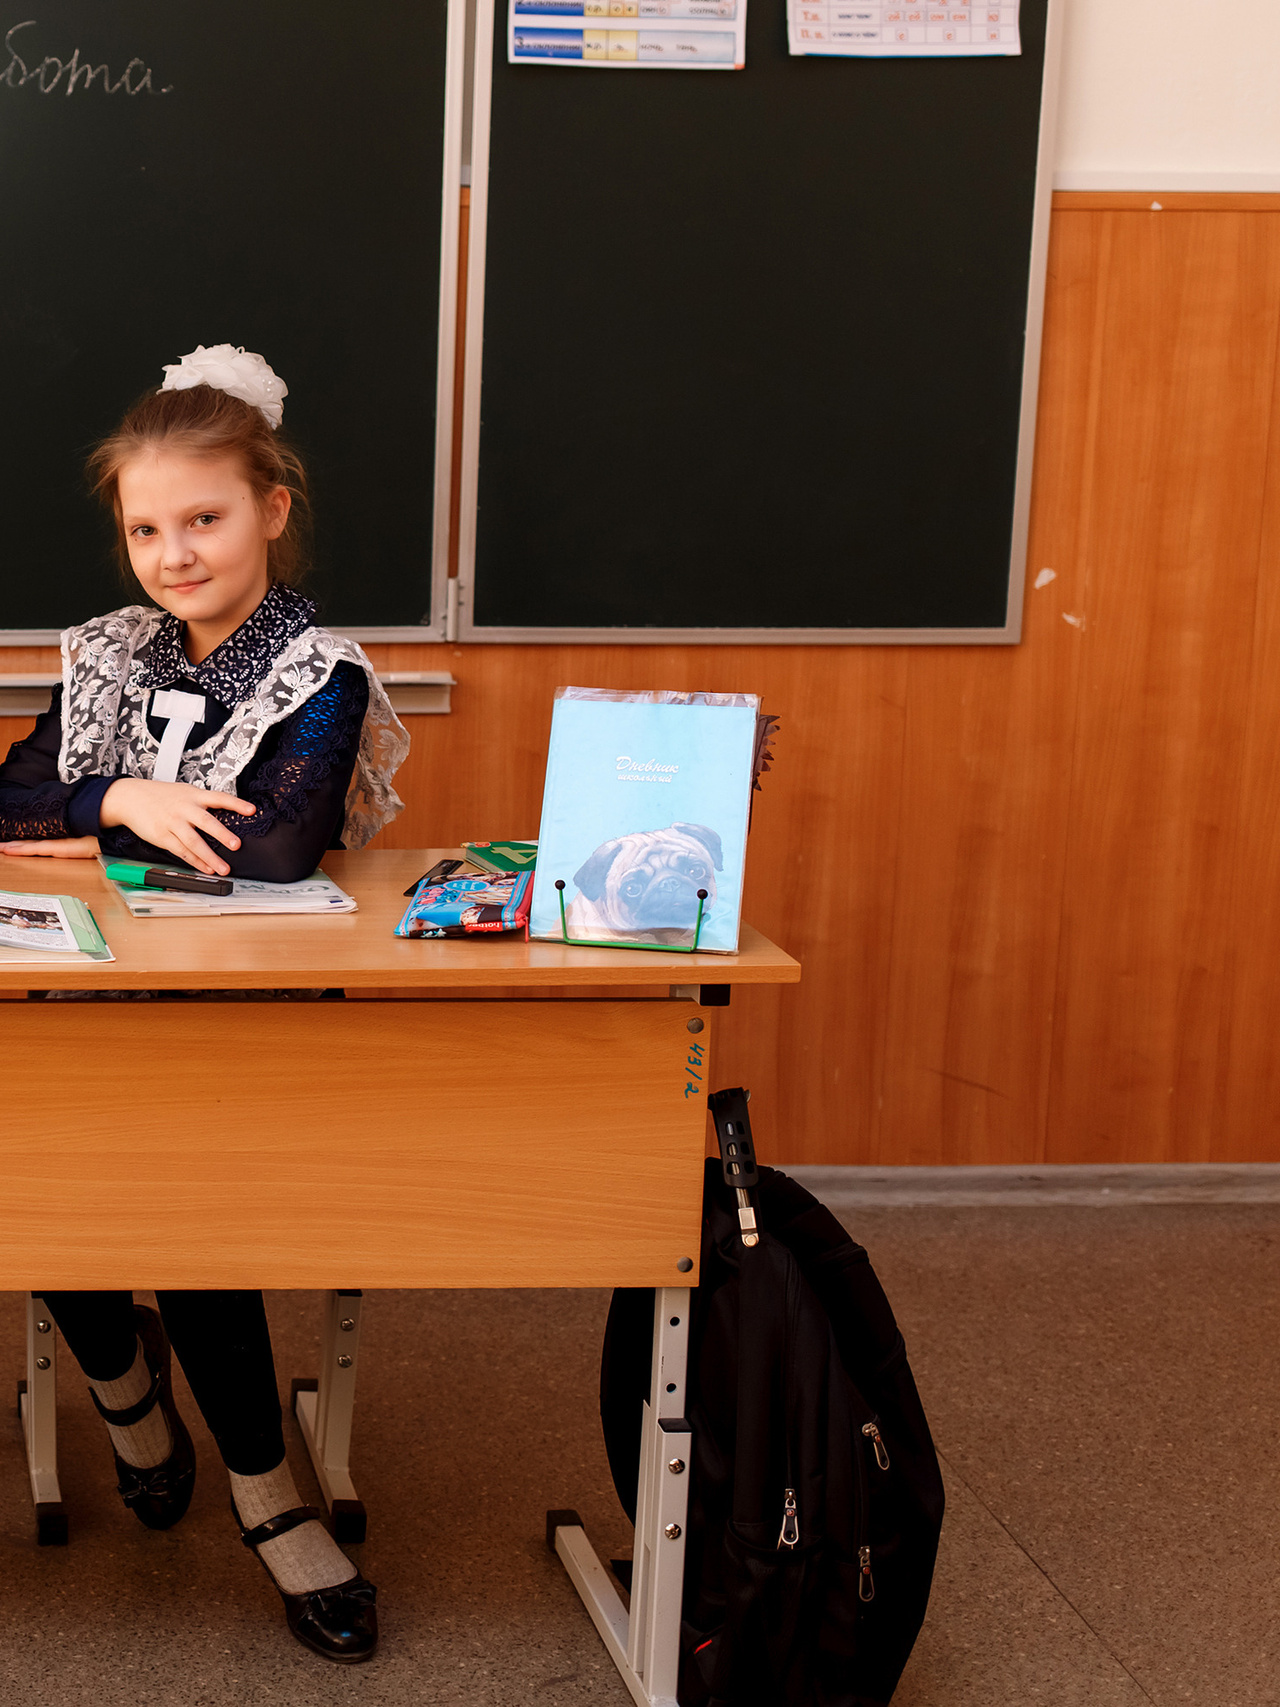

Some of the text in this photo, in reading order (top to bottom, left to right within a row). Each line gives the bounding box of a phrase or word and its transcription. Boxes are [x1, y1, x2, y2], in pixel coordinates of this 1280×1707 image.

[616, 756, 680, 774] Дневник
[617, 774, 673, 784] школьный
[684, 1042, 706, 1099] 43/2
